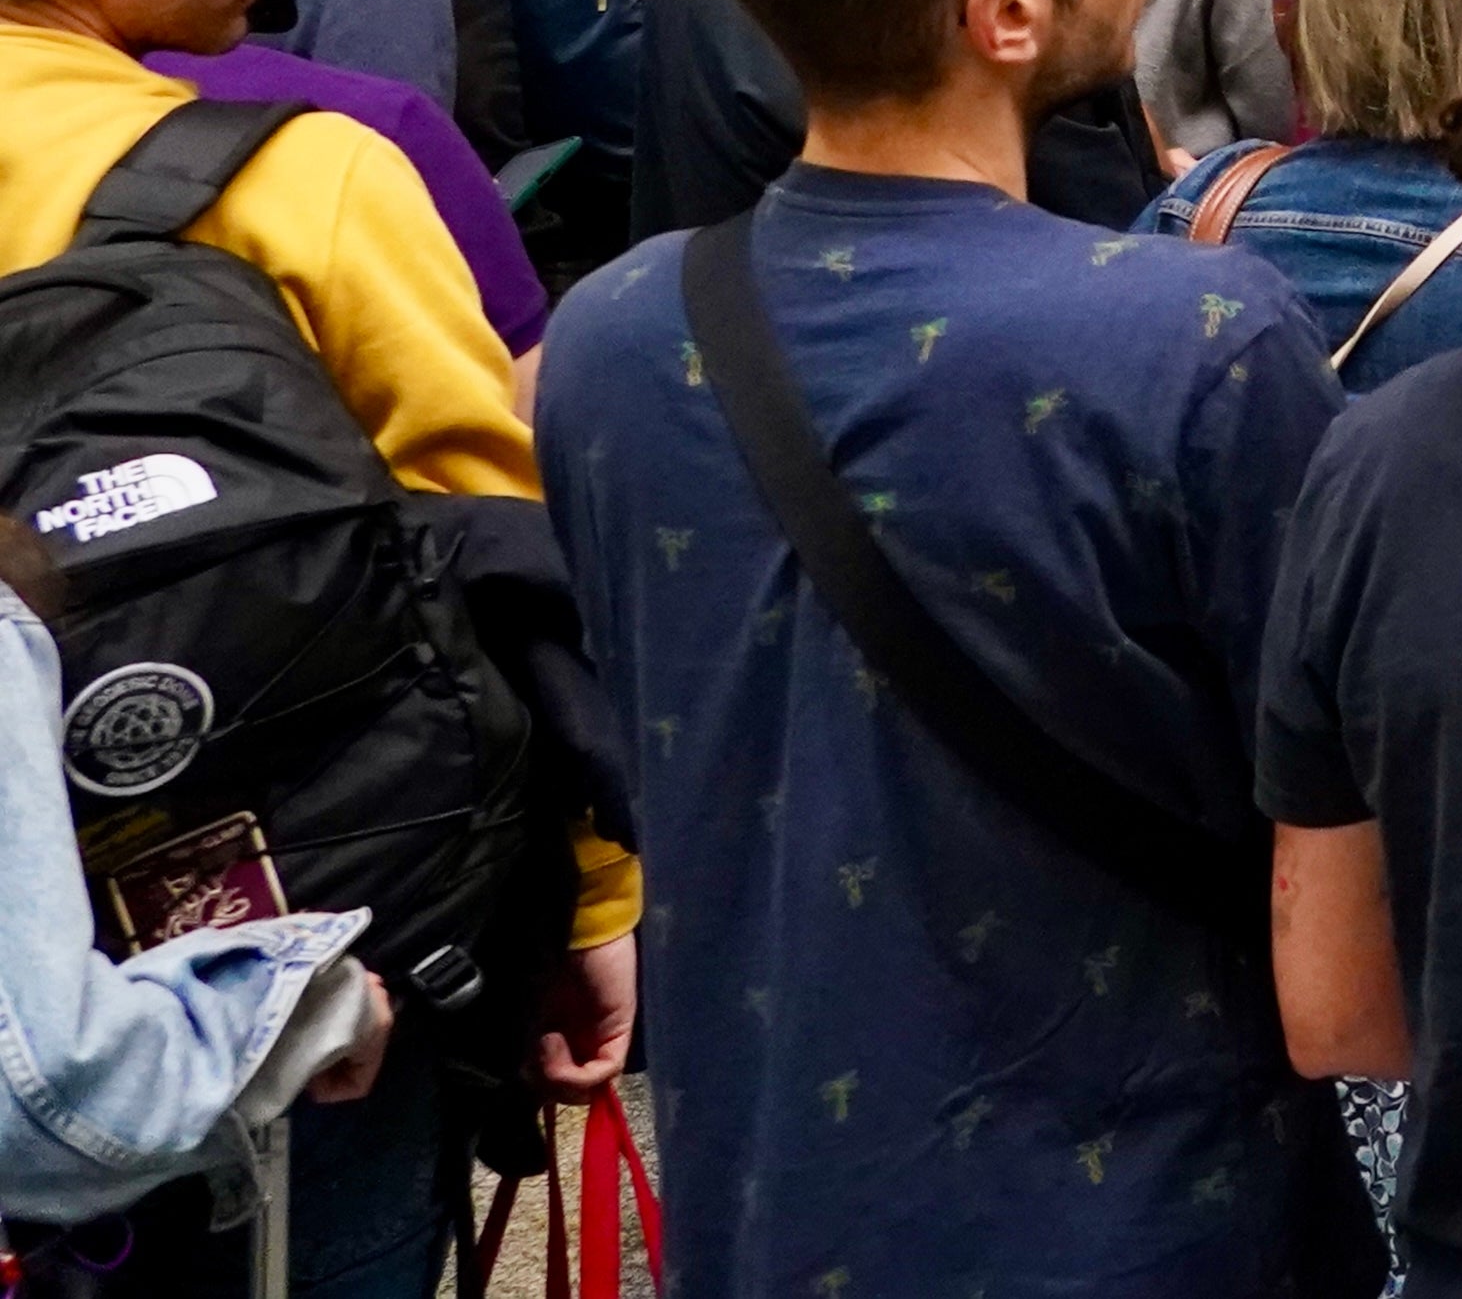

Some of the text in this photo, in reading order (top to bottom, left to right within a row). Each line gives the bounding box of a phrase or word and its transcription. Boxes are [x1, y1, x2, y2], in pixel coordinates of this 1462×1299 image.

[77, 459, 146, 494] THE
[36, 483, 152, 533] NORTH
[74, 500, 158, 543] FACE
